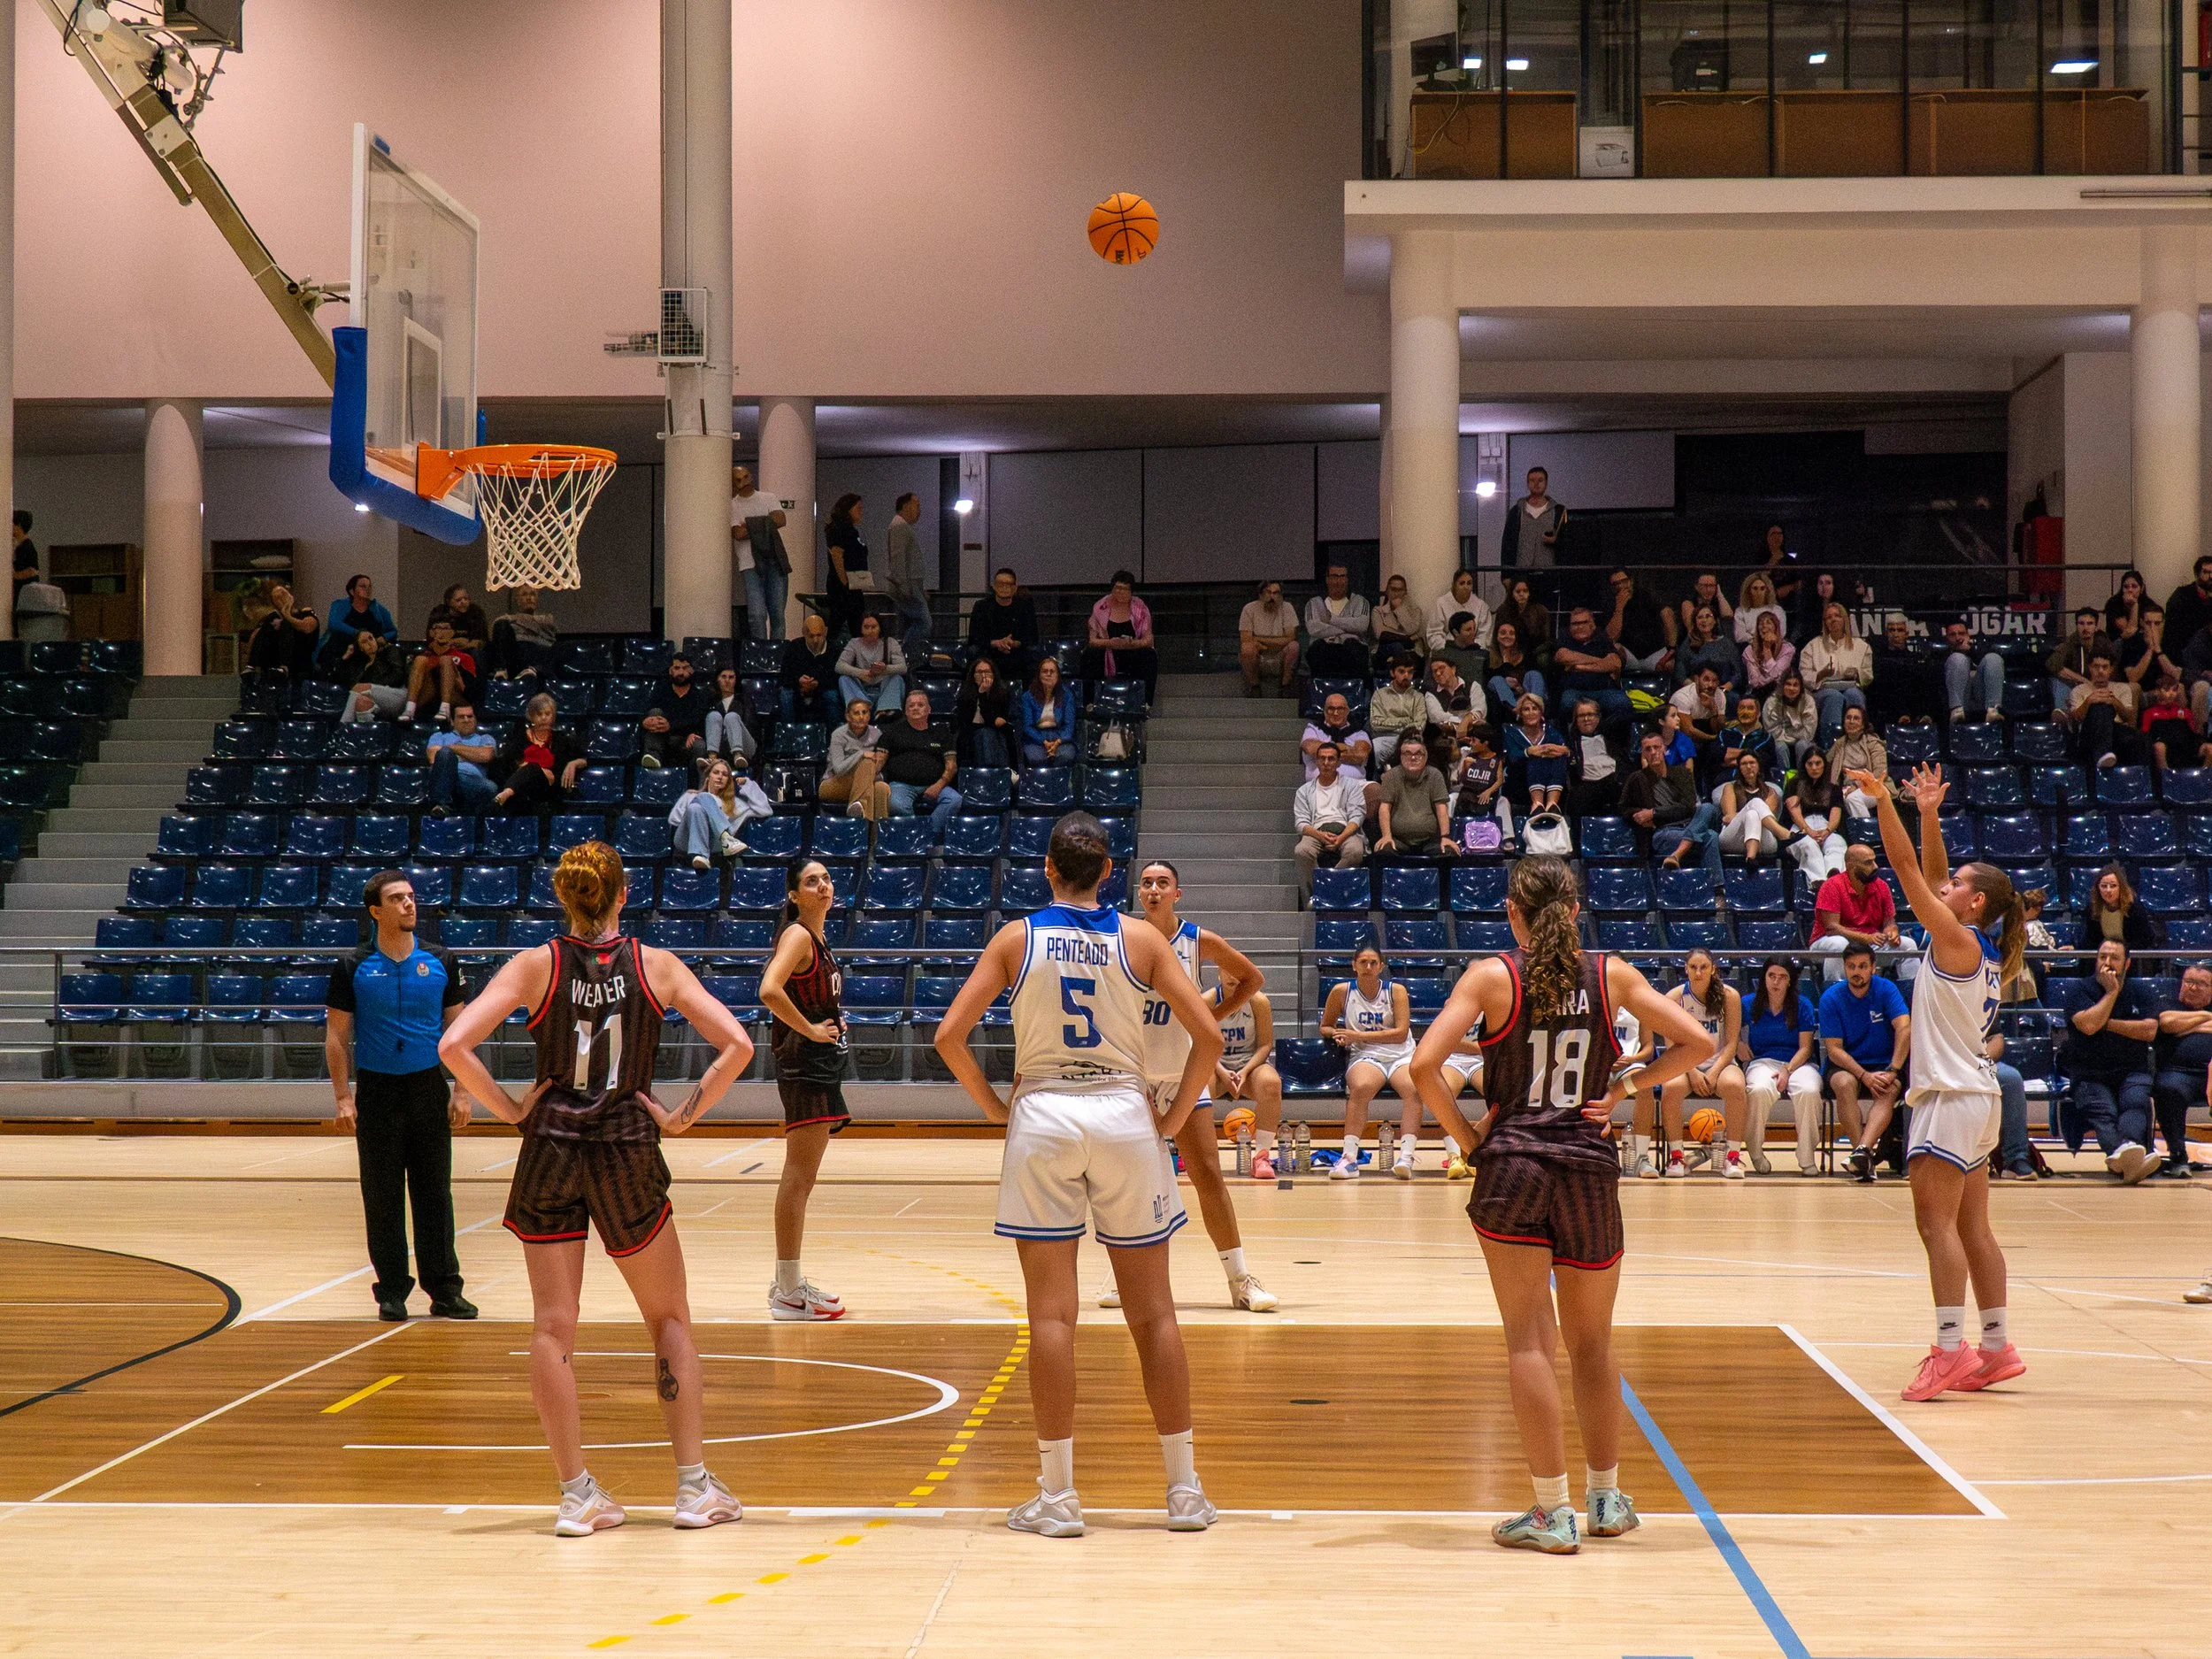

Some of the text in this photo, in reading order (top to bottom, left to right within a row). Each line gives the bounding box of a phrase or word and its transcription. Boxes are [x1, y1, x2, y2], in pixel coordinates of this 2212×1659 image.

[1047, 936, 1109, 967] PENTEADO
[1060, 975, 1102, 1048] 5
[1359, 1011, 1384, 1025] CPN
[573, 1013, 623, 1091] 11
[1527, 1028, 1591, 1109] 18
